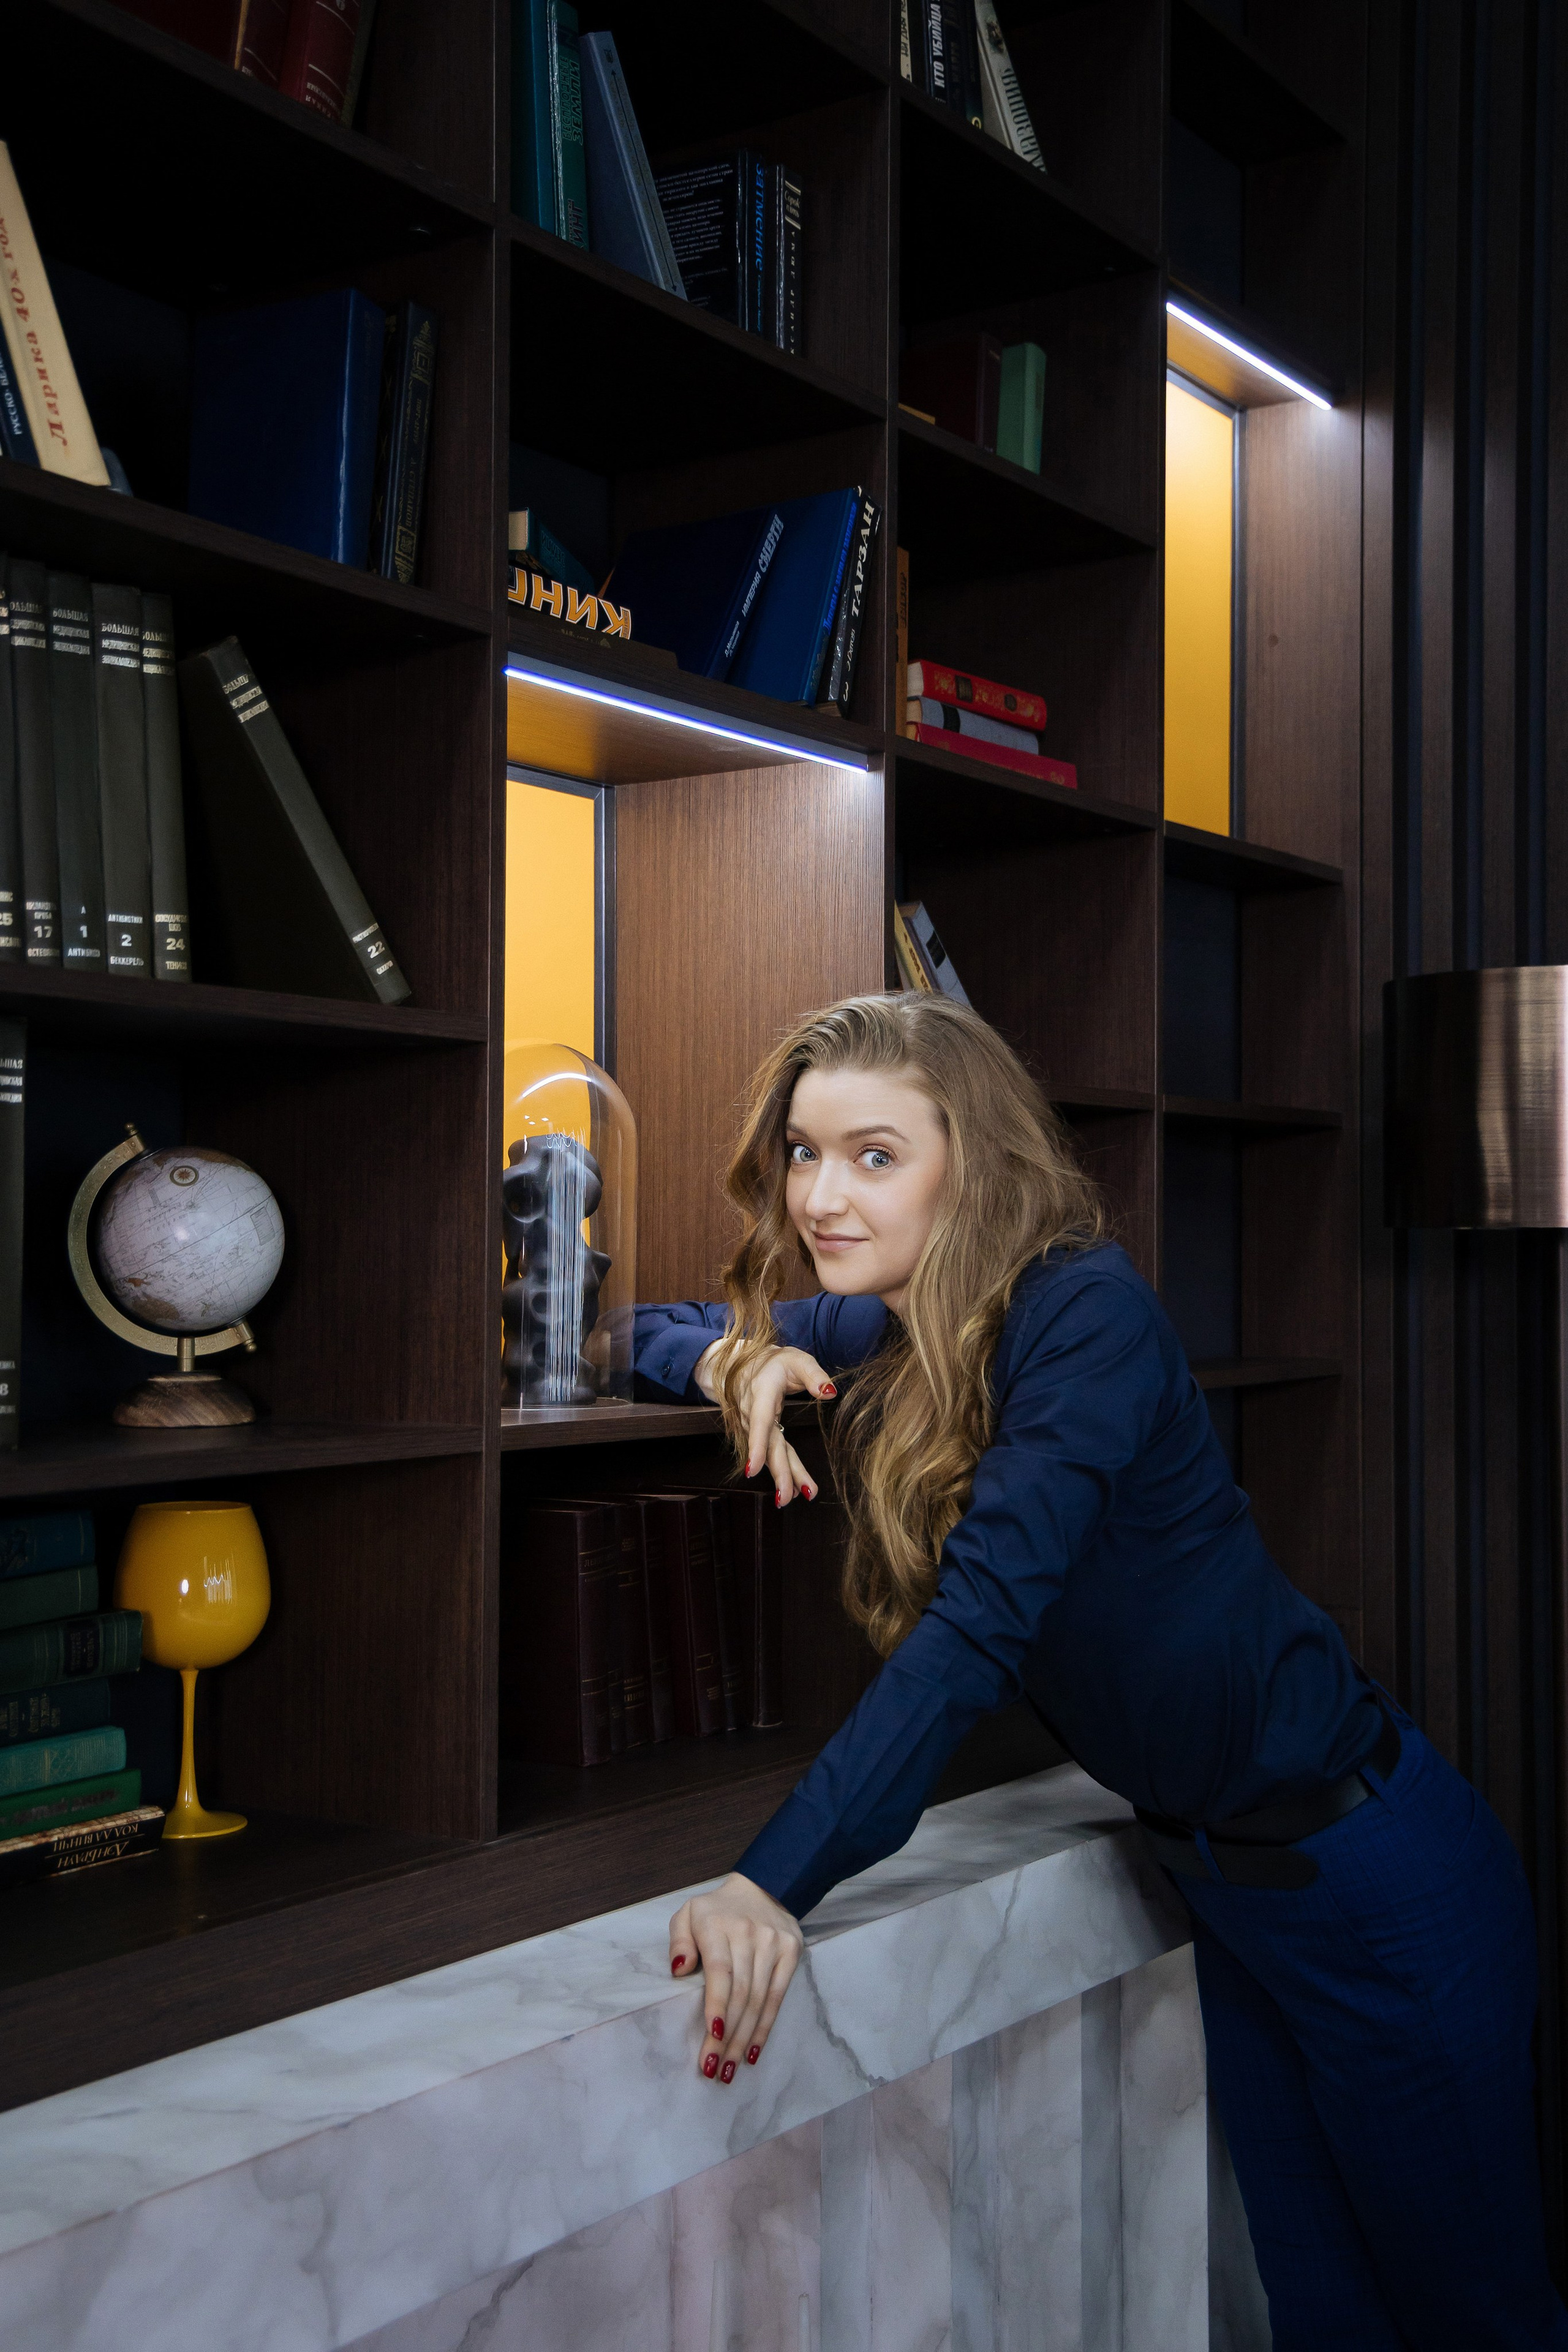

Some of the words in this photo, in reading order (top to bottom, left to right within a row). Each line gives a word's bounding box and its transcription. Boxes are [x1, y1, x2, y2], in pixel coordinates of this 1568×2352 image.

[933, 61, 945, 89] КТО
[559, 55, 573, 141] БЕСПЛОДНЫЕ
[571, 58, 584, 146] ЗЕМЛИ
[785, 189, 801, 209] Сорок
[742, 570, 761, 618] ИМПЕРИЯ
[758, 514, 785, 574] СМЕРТИ
[851, 501, 875, 619] ТАРЗАН
[53, 608, 89, 622] БОЛЬШАЯ
[102, 623, 140, 636] БОЛЬШАЯ
[223, 673, 250, 694] БОЛЬШ
[80, 905, 86, 915] А
[34, 925, 53, 938] 17
[80, 925, 88, 938] 1
[121, 934, 132, 948] 2
[166, 938, 186, 951] 24
[368, 941, 385, 959] 22
[96, 1828, 113, 1842] ДА
[115, 1823, 139, 1838] КОД
[53, 1834, 93, 1852] ВИНЧИ
[97, 1841, 130, 1858] ДЭН
[57, 1849, 97, 1868] БРАУН
